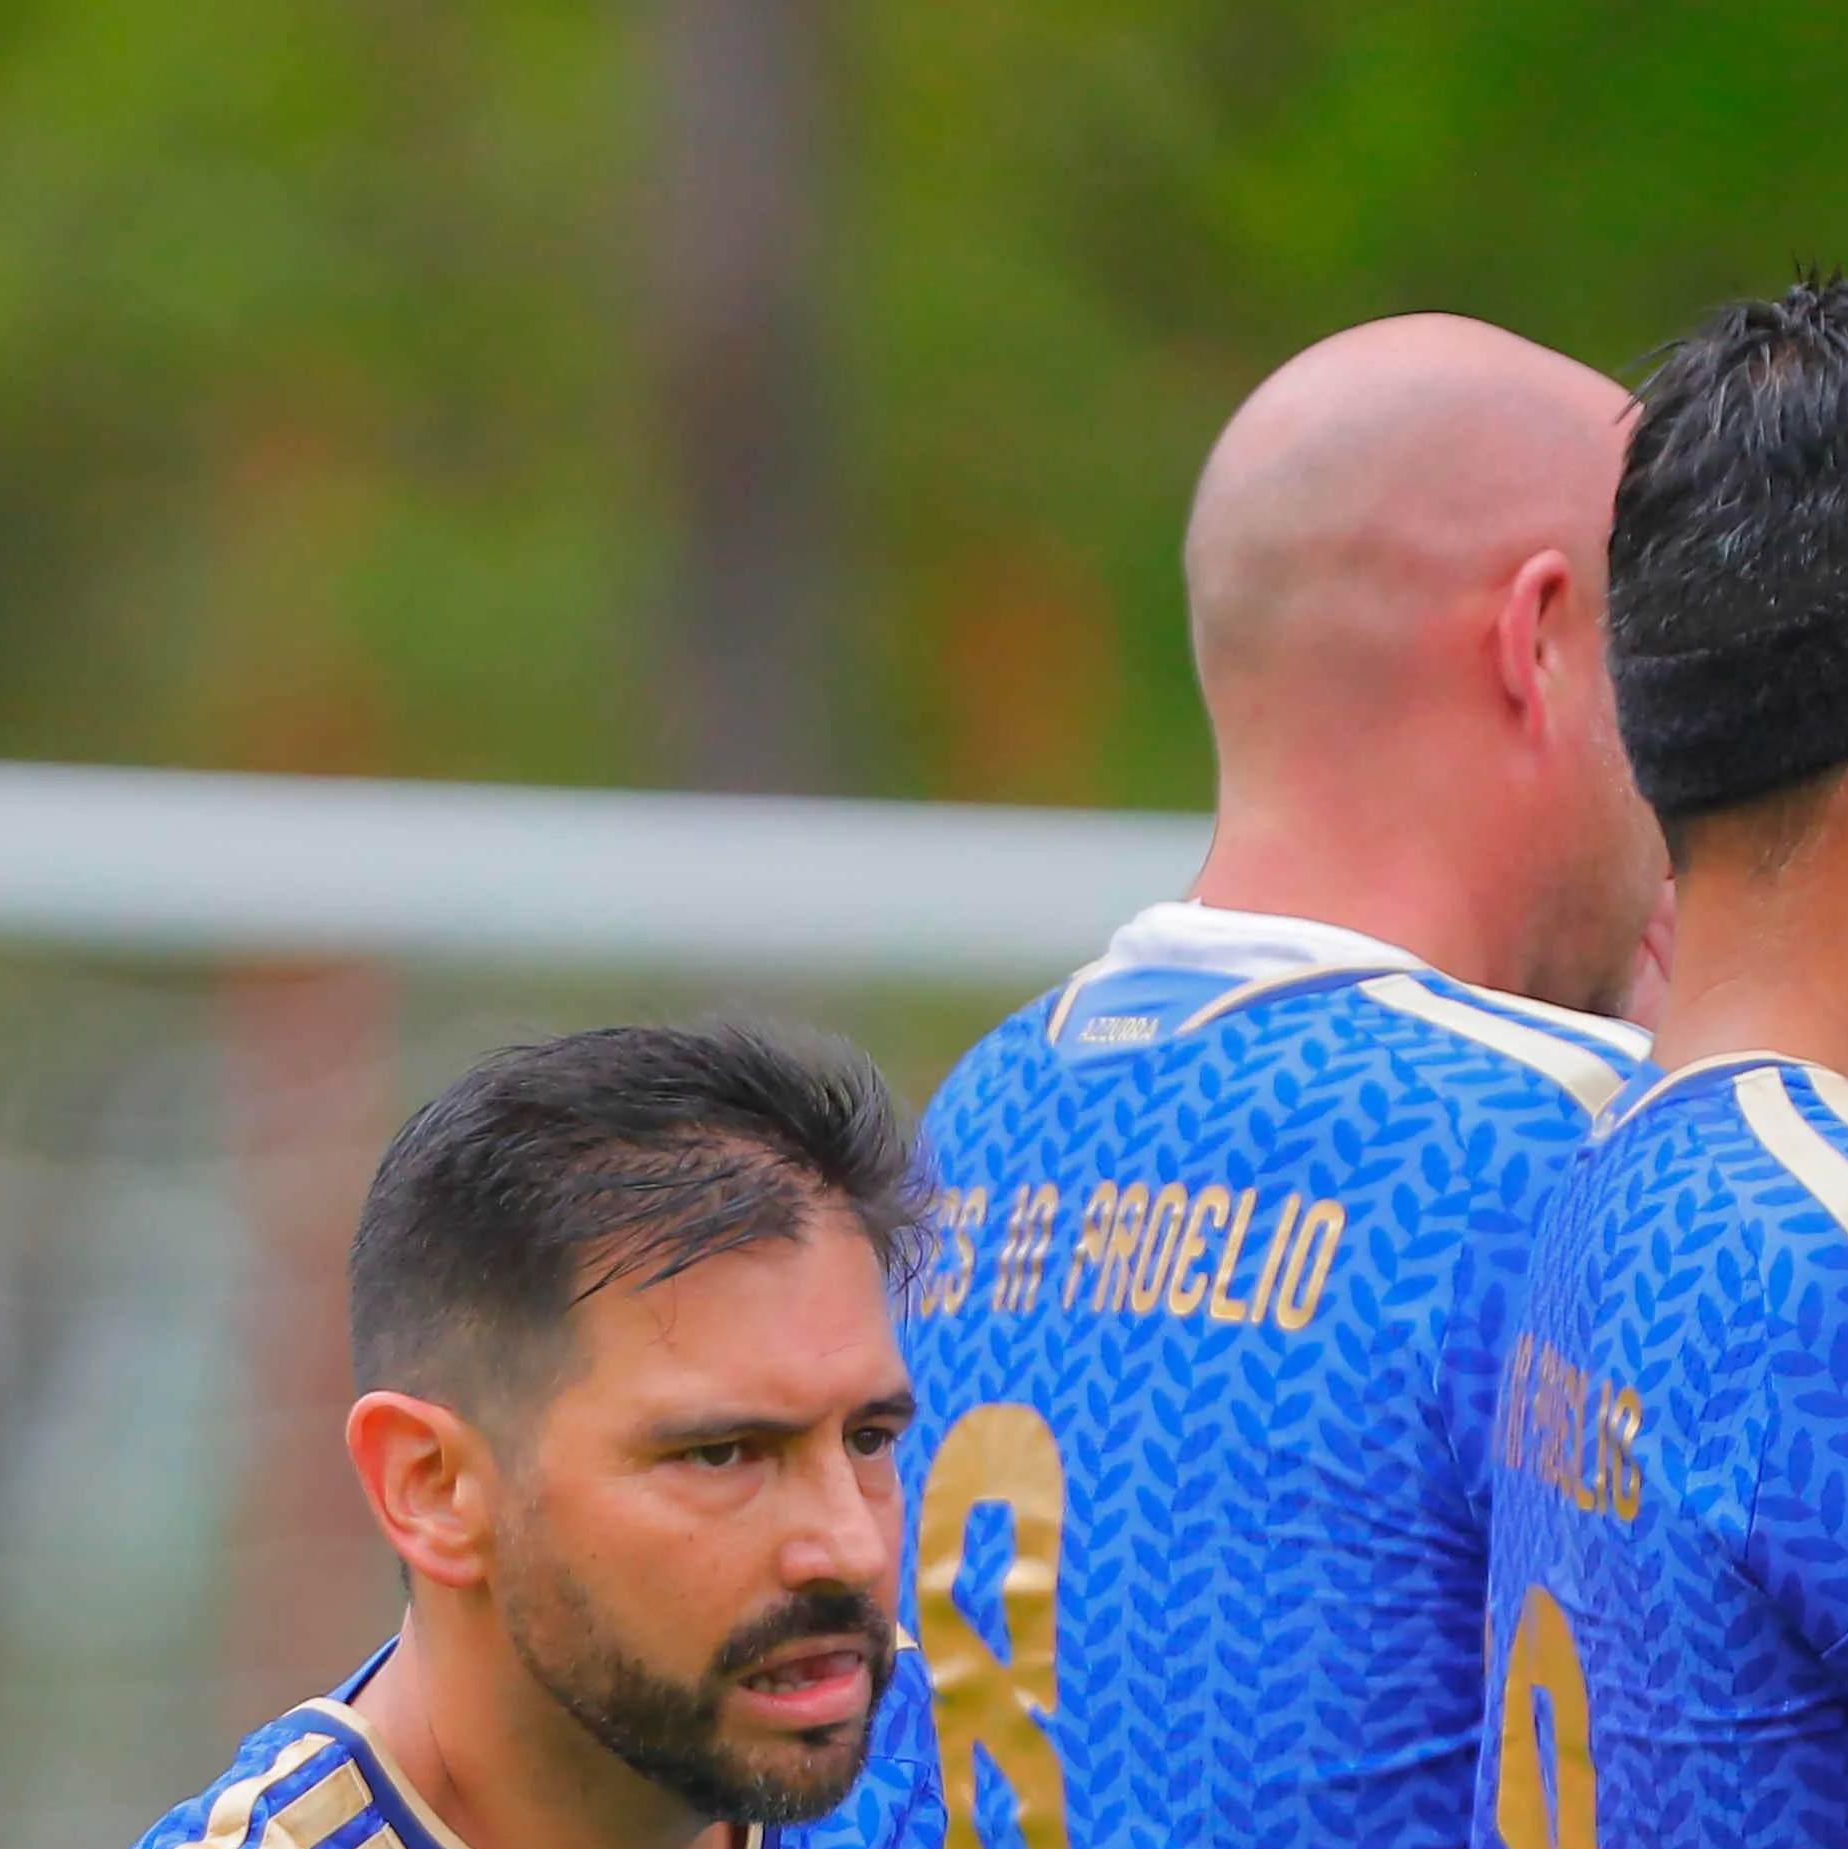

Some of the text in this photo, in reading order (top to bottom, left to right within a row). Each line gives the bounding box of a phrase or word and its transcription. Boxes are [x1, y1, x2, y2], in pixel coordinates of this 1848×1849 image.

[1077, 1016, 1161, 1043] AZZURRA
[992, 1182, 1059, 1313] IN
[1063, 1178, 1347, 1331] PROELIO
